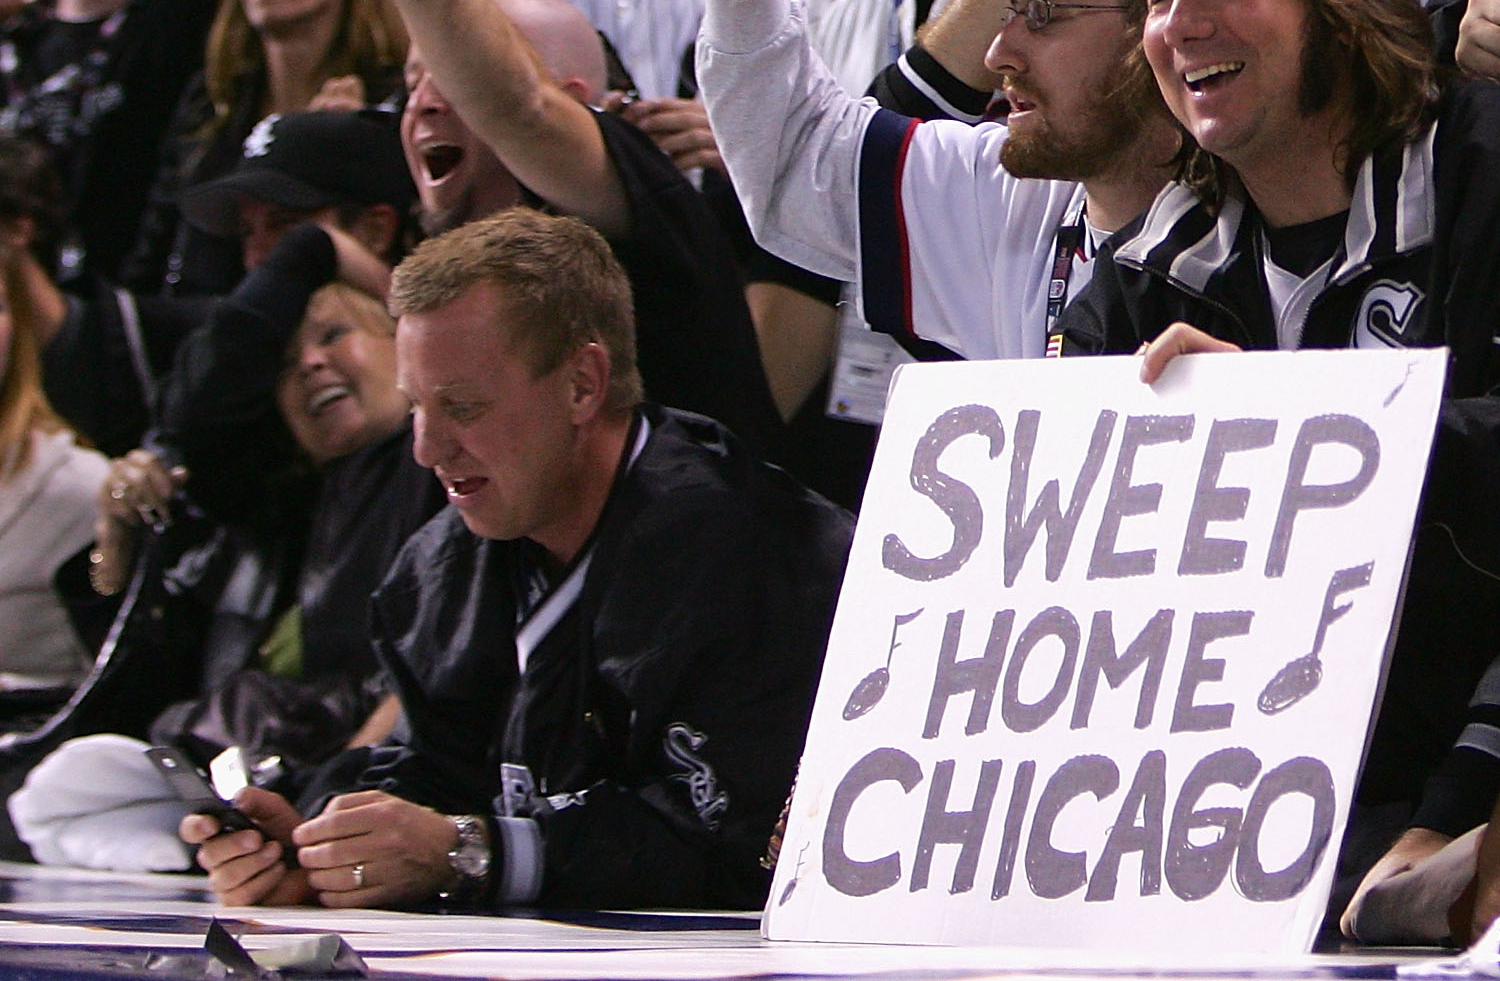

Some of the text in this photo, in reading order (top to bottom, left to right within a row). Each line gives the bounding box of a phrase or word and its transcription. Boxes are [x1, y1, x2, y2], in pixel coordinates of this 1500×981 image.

[881, 404, 1381, 587] SWEEP
[923, 606, 1255, 739] HOME
[821, 746, 1336, 902] CHICAGO
